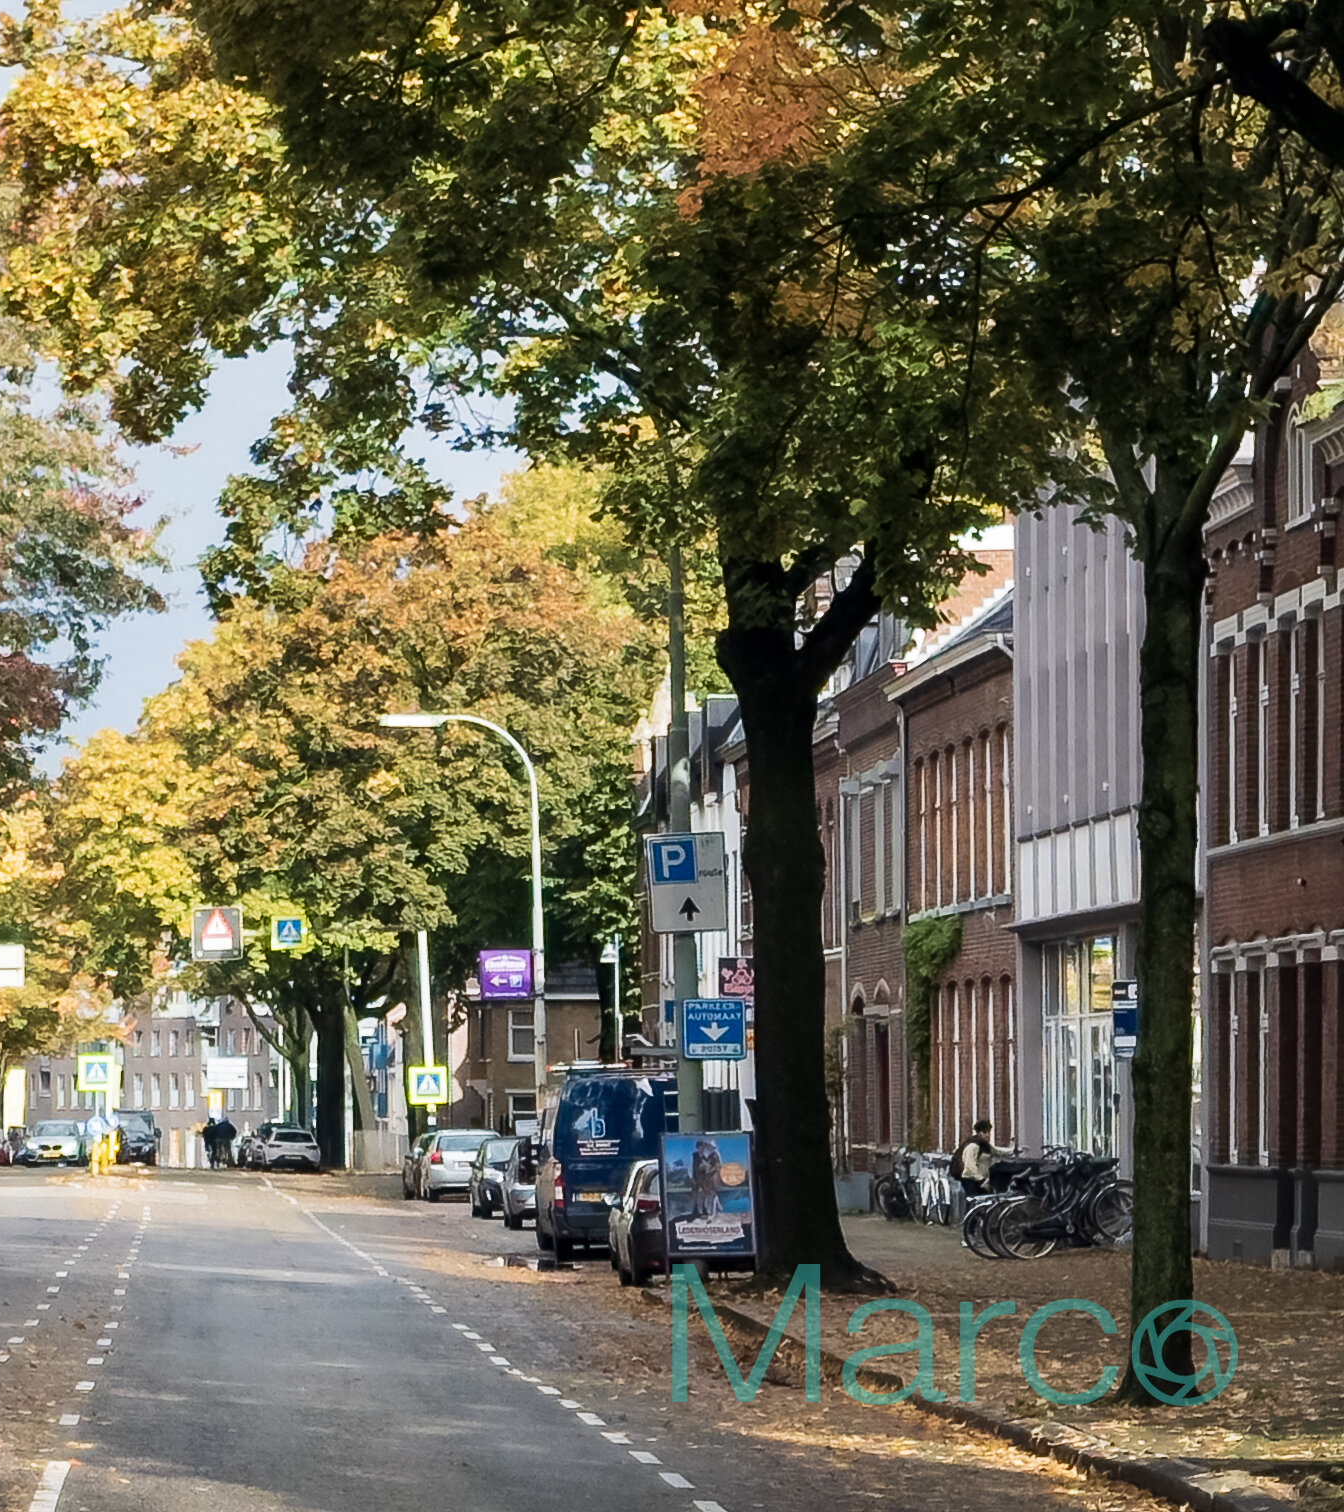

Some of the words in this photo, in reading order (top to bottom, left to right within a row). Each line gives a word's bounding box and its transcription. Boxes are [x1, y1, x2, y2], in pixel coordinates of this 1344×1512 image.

[660, 844, 687, 879] P
[698, 867, 723, 878] route
[687, 1012, 742, 1021] AUTOMAAT
